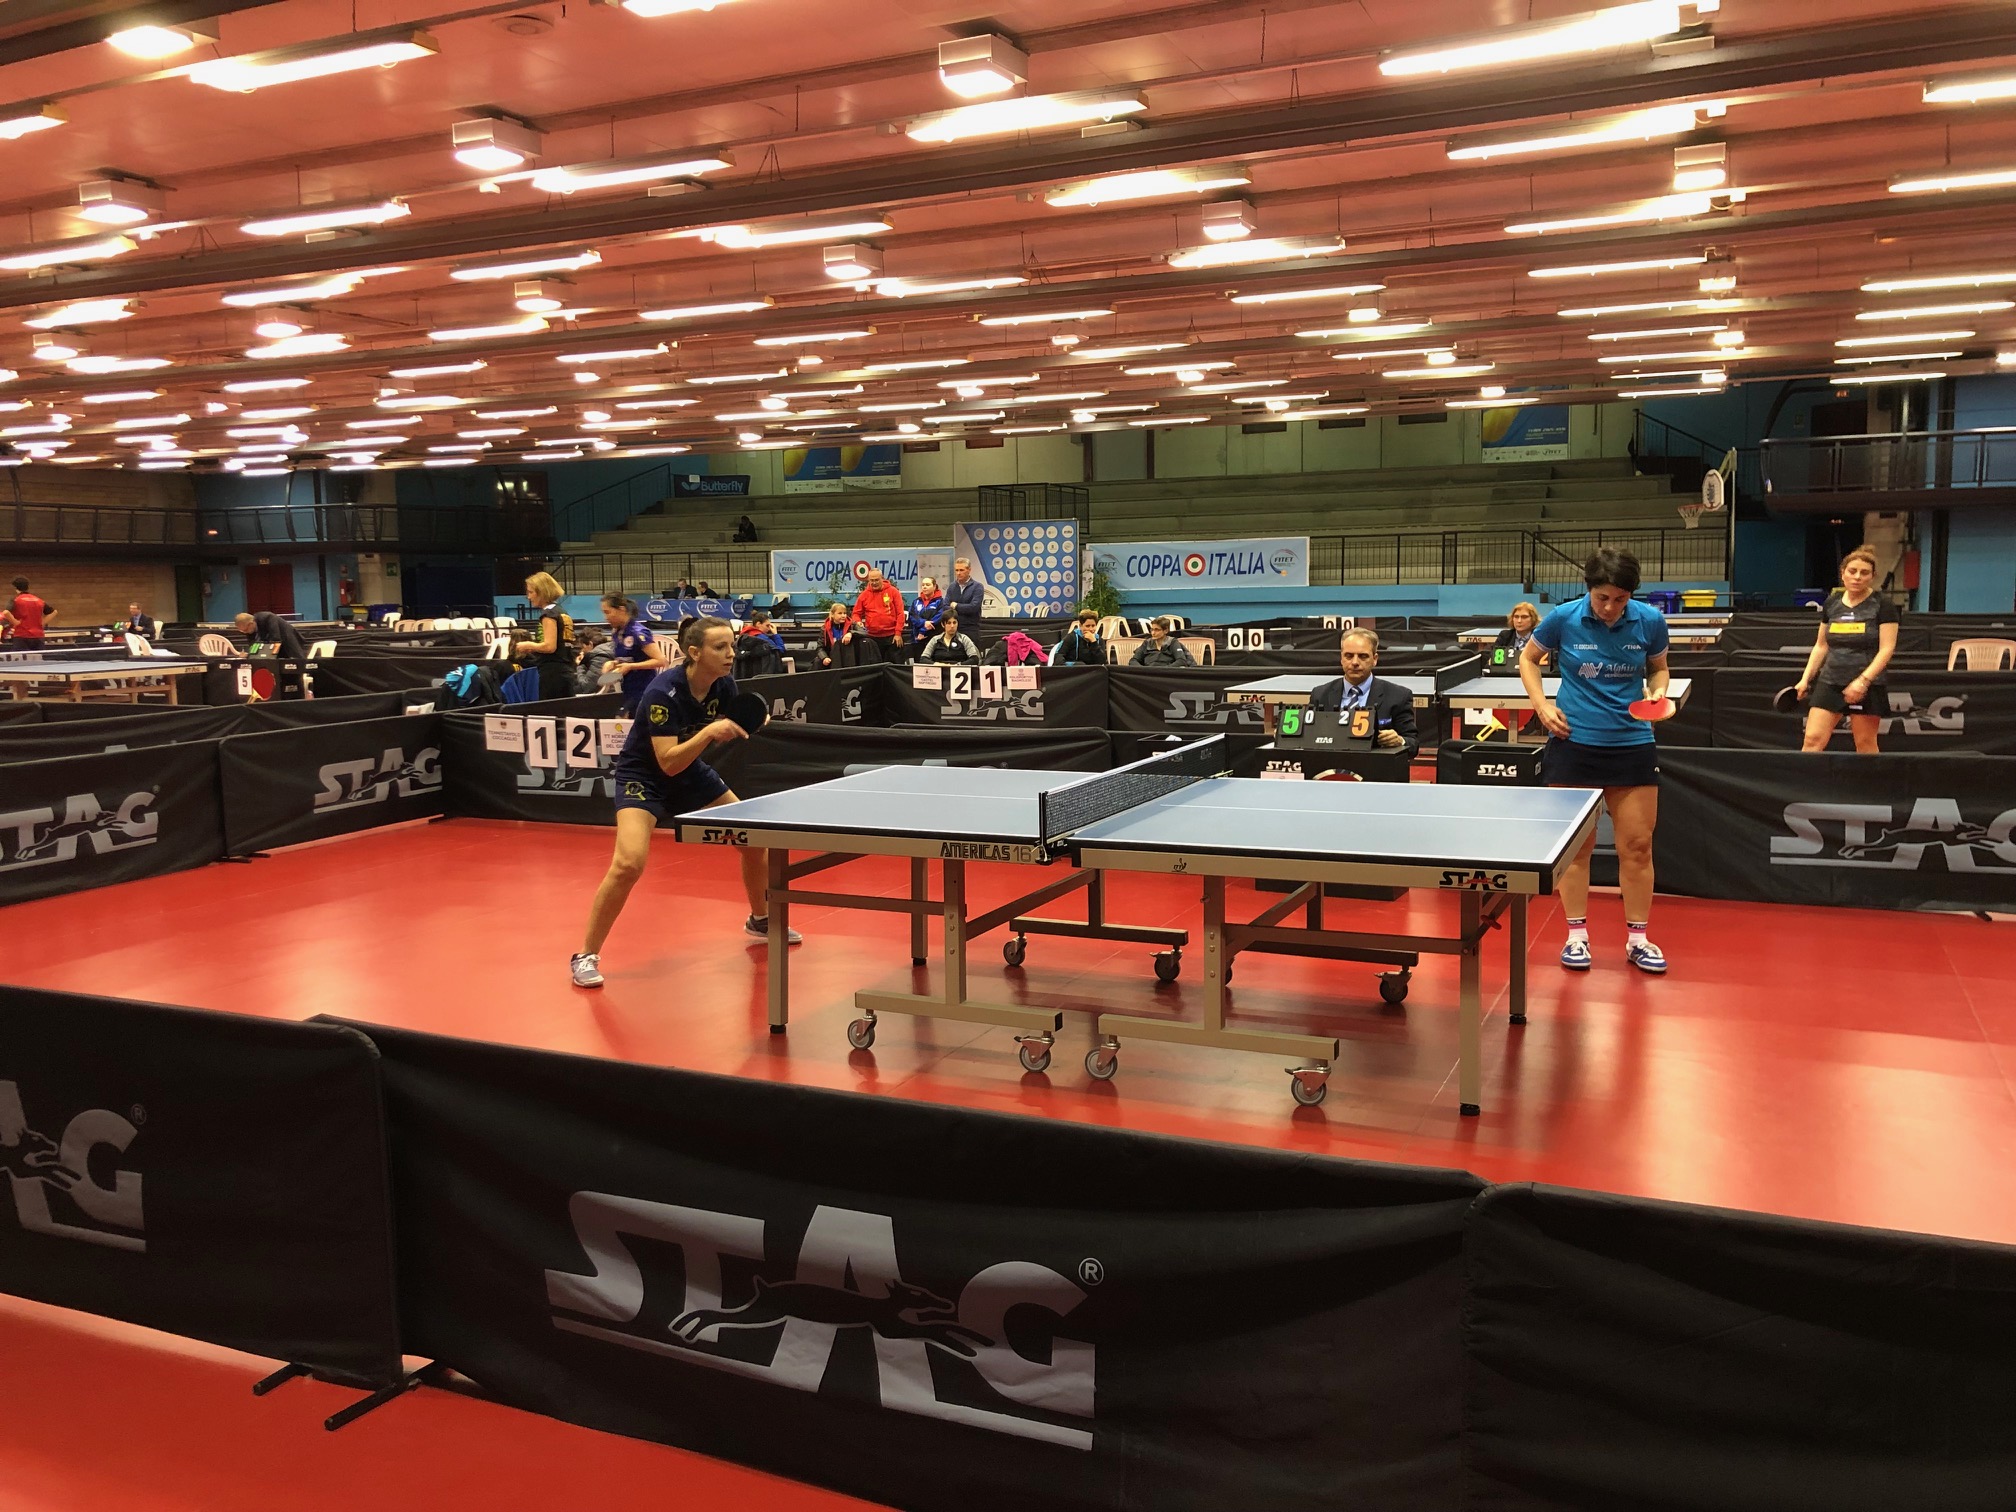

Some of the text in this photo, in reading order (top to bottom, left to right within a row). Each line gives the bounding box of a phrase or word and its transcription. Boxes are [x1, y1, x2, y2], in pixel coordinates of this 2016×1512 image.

[701, 480, 744, 493] Butterfly
[805, 559, 918, 582] COPPA ITALIA
[1126, 551, 1265, 578] COPPA ITALIA
[1343, 619, 1352, 630] 0
[1230, 632, 1261, 648] 0 0
[1494, 648, 1505, 664] 8
[1507, 649, 1515, 658] 2
[241, 675, 248, 688] 5
[954, 671, 969, 694] 2
[985, 670, 996, 693] 1
[1239, 694, 1266, 703] STAG
[1282, 709, 1370, 736] 5 0 2 5
[534, 727, 549, 760] 1
[572, 724, 592, 759] 2
[1315, 736, 1334, 744] STAG
[1265, 760, 1302, 773] STAG
[1477, 763, 1517, 778] STAG
[314, 746, 443, 814] STAG
[0, 792, 158, 871] TAG
[702, 828, 748, 846] STAG
[940, 841, 1032, 862] AMERICAS 16
[1439, 869, 1508, 892] STAG
[544, 1190, 1097, 1452] STAG
